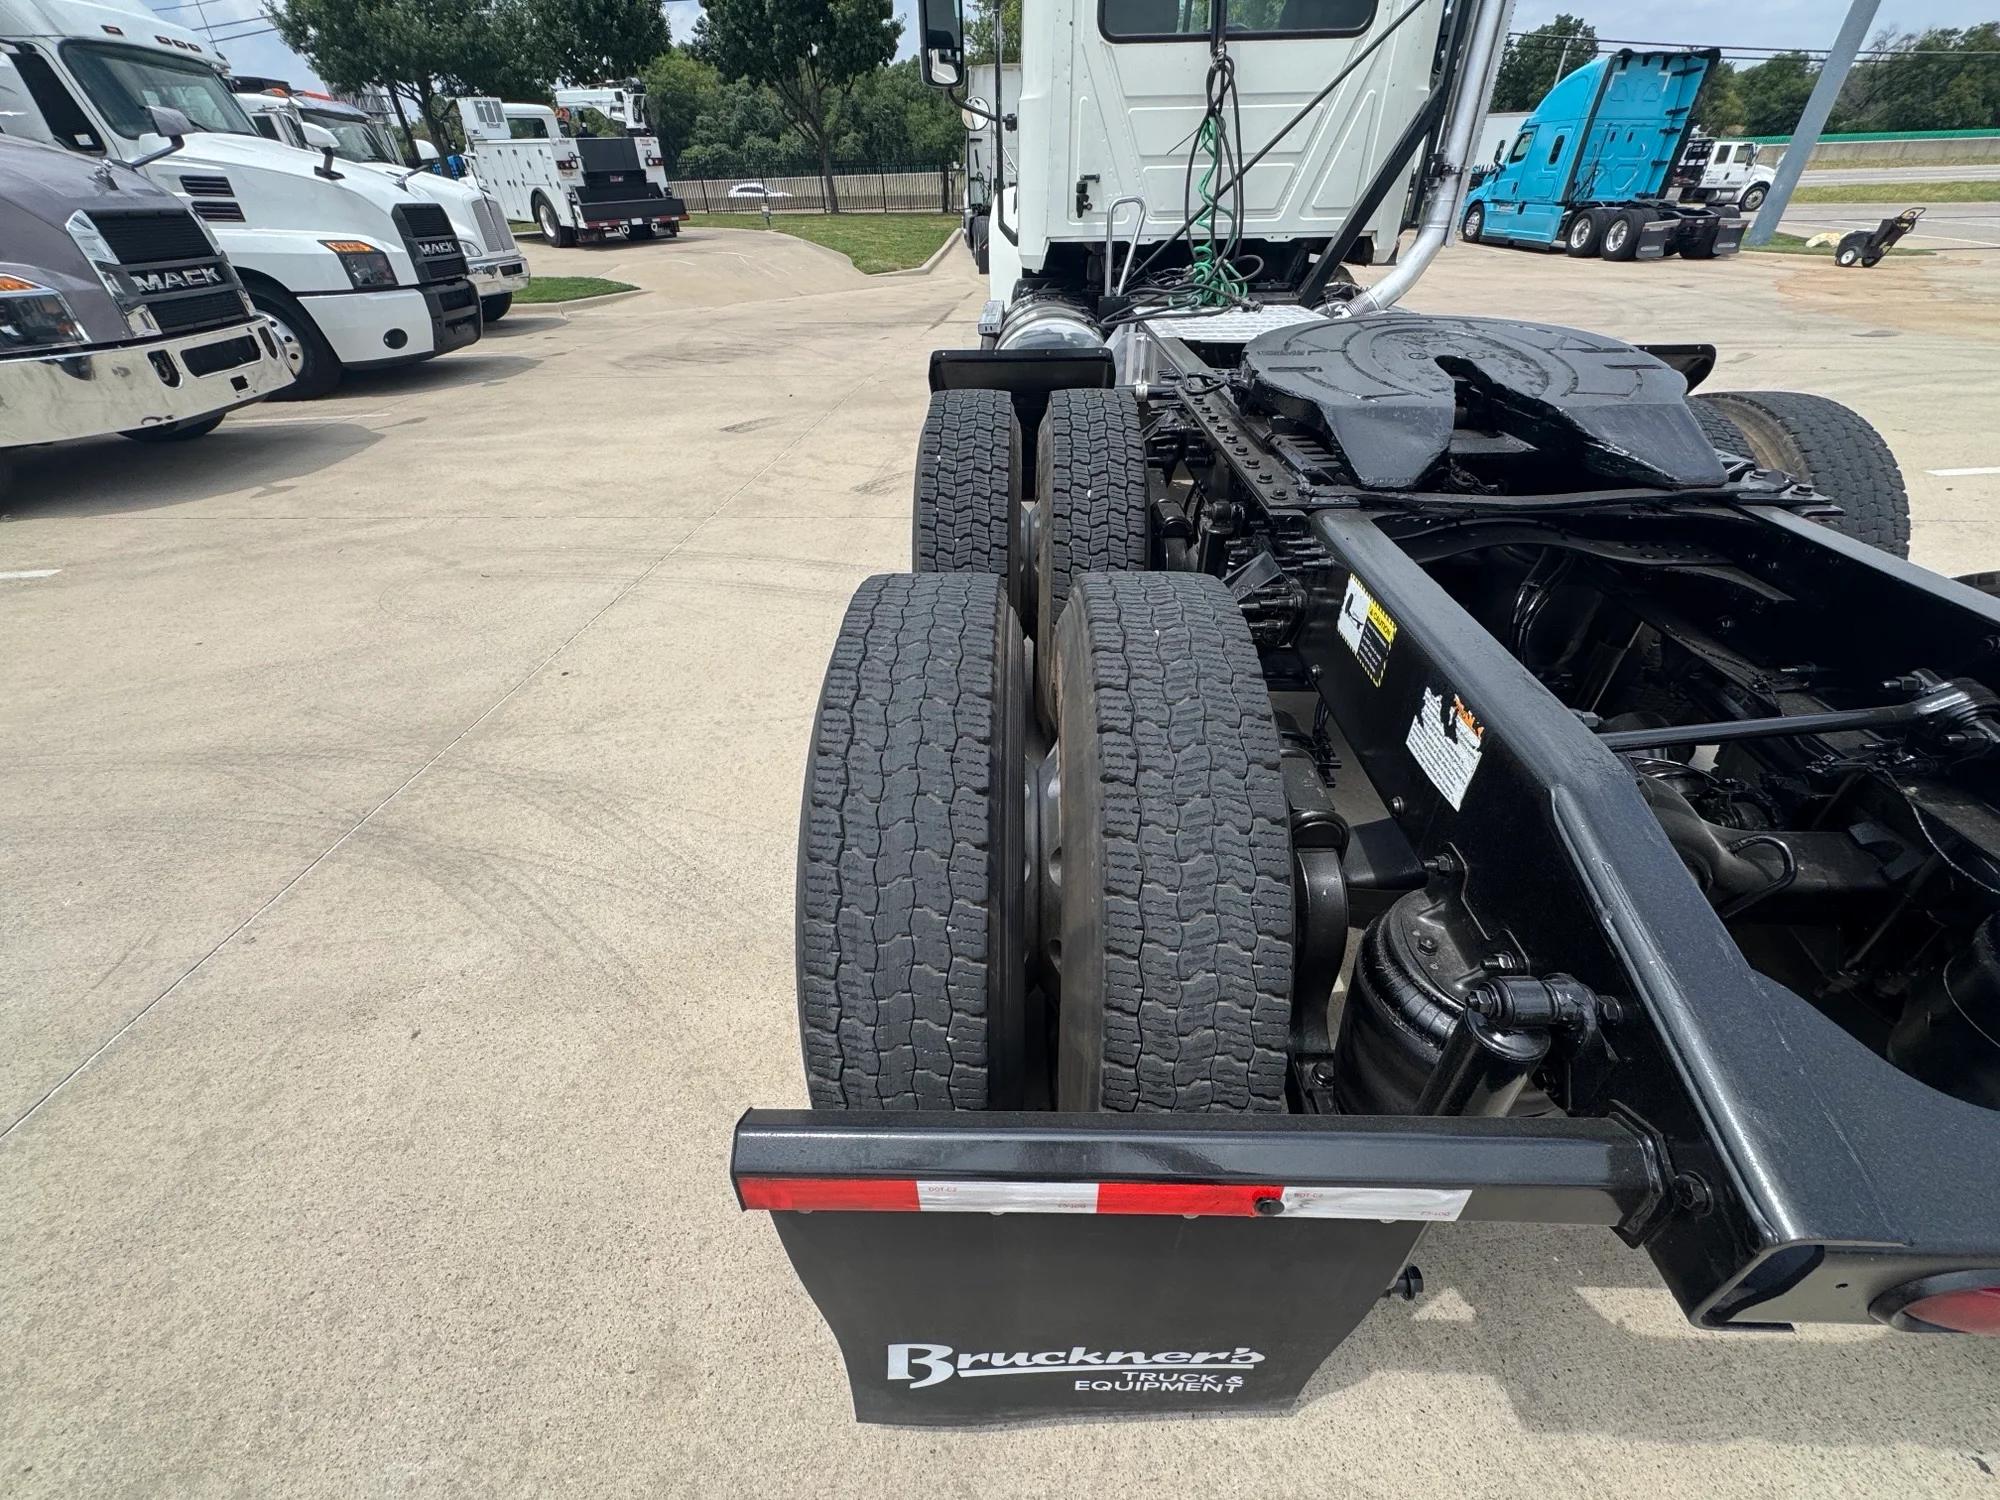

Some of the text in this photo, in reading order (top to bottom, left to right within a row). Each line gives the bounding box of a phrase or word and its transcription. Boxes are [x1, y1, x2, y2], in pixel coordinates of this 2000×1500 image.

[417, 241, 456, 255] MACK
[131, 267, 221, 292] MACK
[1373, 611, 1392, 638] CAUTION
[887, 1343, 1265, 1389] Bruckner's
[1074, 1380, 1243, 1394] EQUIPMENT
[1122, 1371, 1245, 1385] TRUCK &
